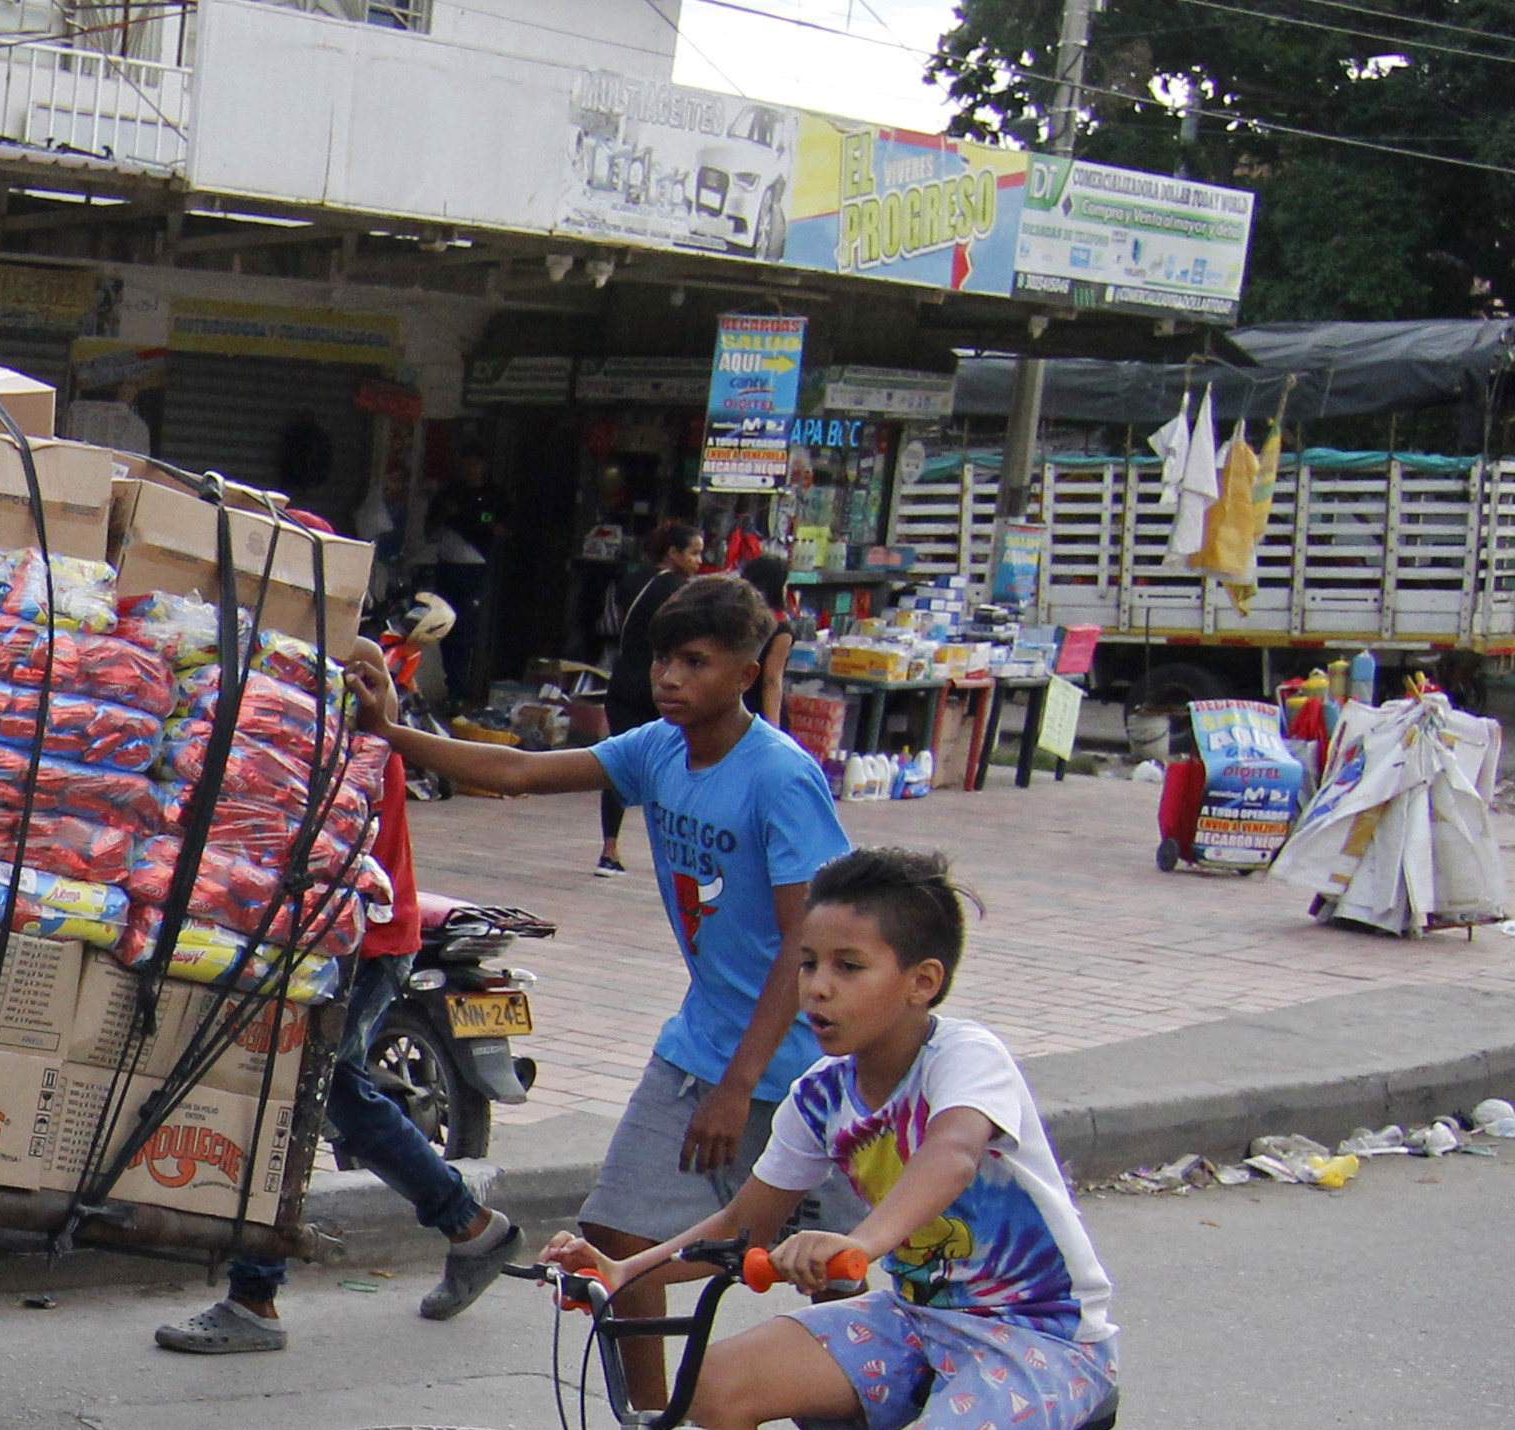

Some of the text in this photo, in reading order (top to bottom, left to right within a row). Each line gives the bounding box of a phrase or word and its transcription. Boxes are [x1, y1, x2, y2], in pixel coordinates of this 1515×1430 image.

[843, 132, 874, 200] EL
[840, 169, 996, 271] PROGRESO
[721, 317, 802, 333] RECARGAS
[720, 333, 802, 350] SALDO
[718, 352, 762, 374] AQUI
[1209, 727, 1285, 750] AQUI
[1223, 765, 1283, 780] DIGITEL
[1195, 831, 1253, 846] RECARGO
[46, 886, 82, 902] Aroma
